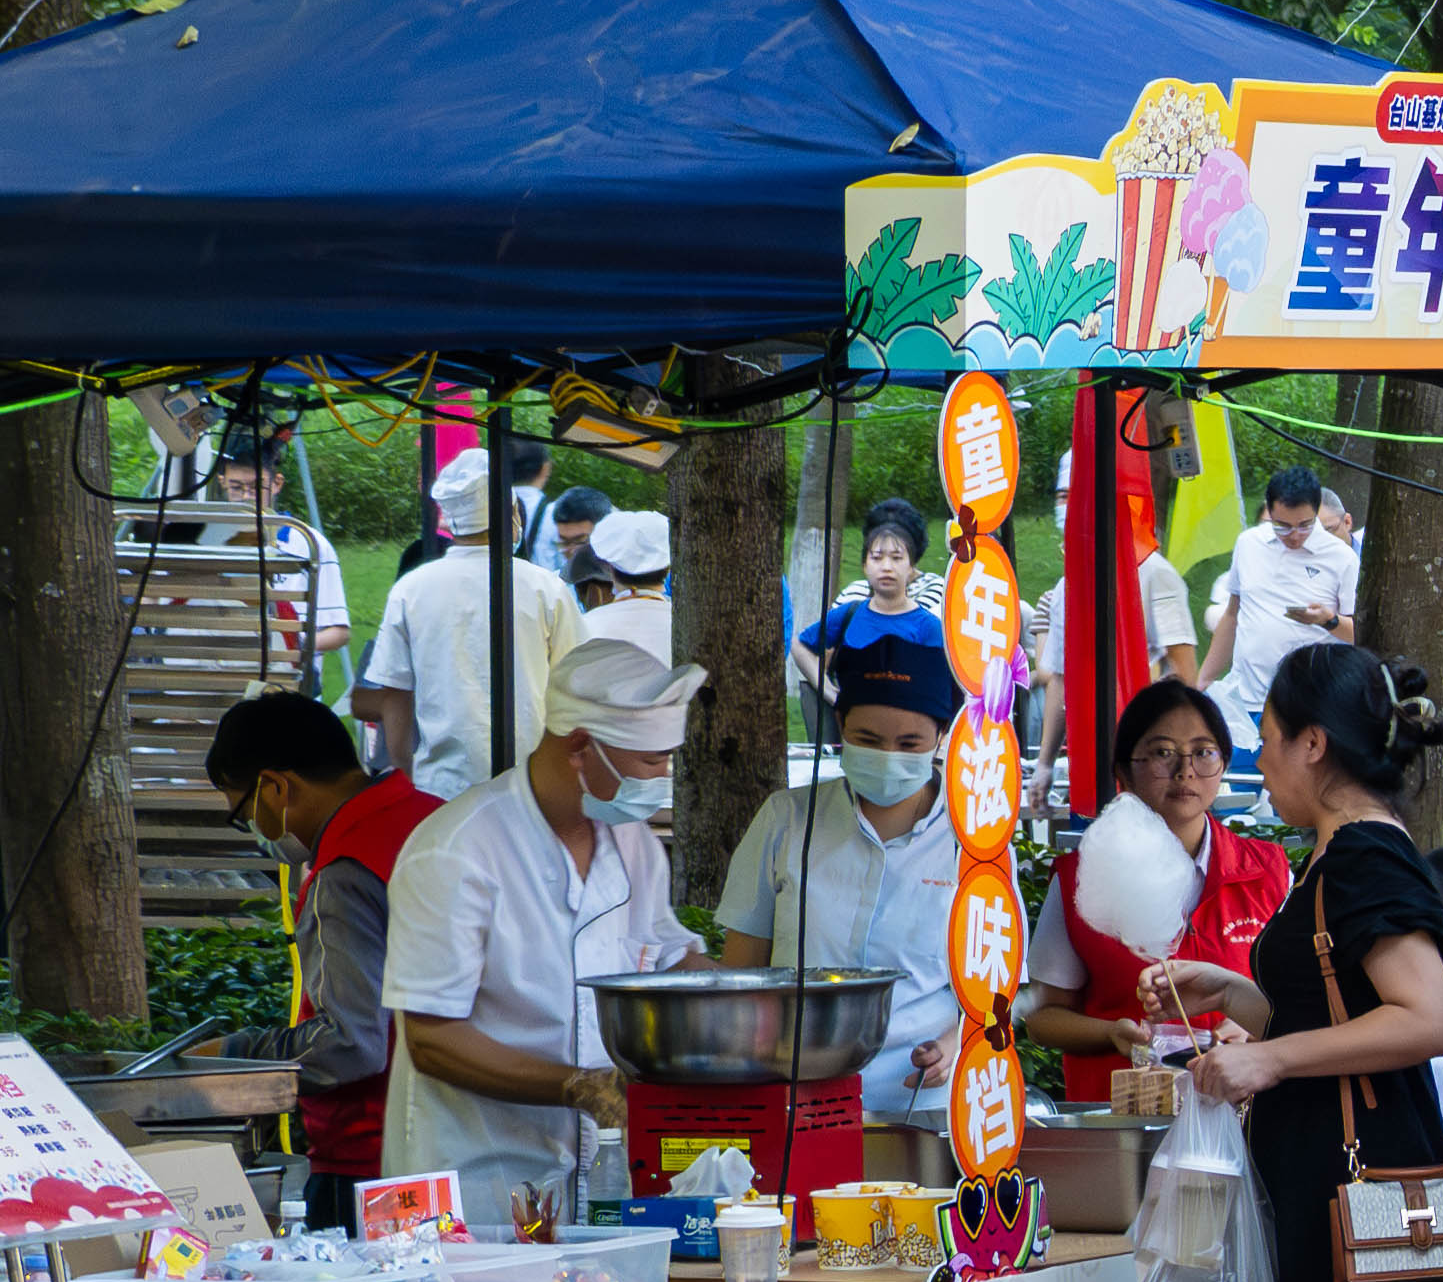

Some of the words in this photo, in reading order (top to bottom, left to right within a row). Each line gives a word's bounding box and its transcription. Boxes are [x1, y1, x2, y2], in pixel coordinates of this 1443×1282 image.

[957, 403, 1019, 1164] 童年滋味档
